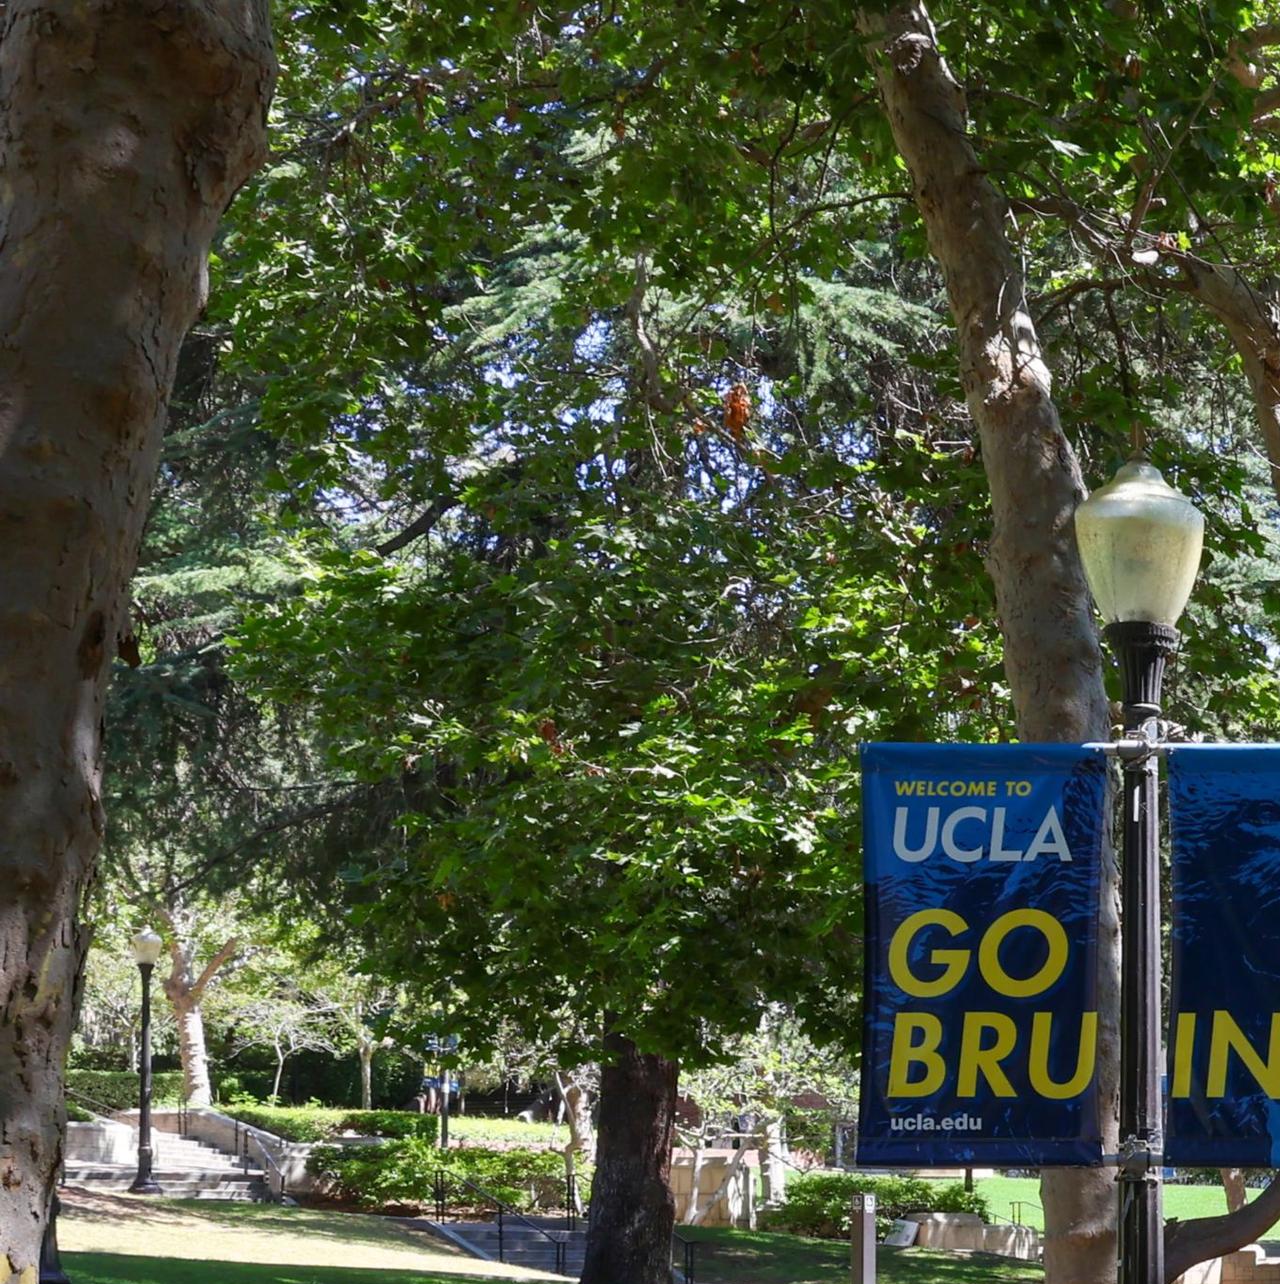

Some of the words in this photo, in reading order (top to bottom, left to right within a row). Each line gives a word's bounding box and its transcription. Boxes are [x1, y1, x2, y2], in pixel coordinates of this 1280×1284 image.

[895, 781, 997, 797] WELCOME
[1006, 780, 1032, 797] TO
[892, 804, 1073, 862] UCLA
[887, 908, 1070, 998] GO
[890, 1113, 982, 1131] ucla.edu
